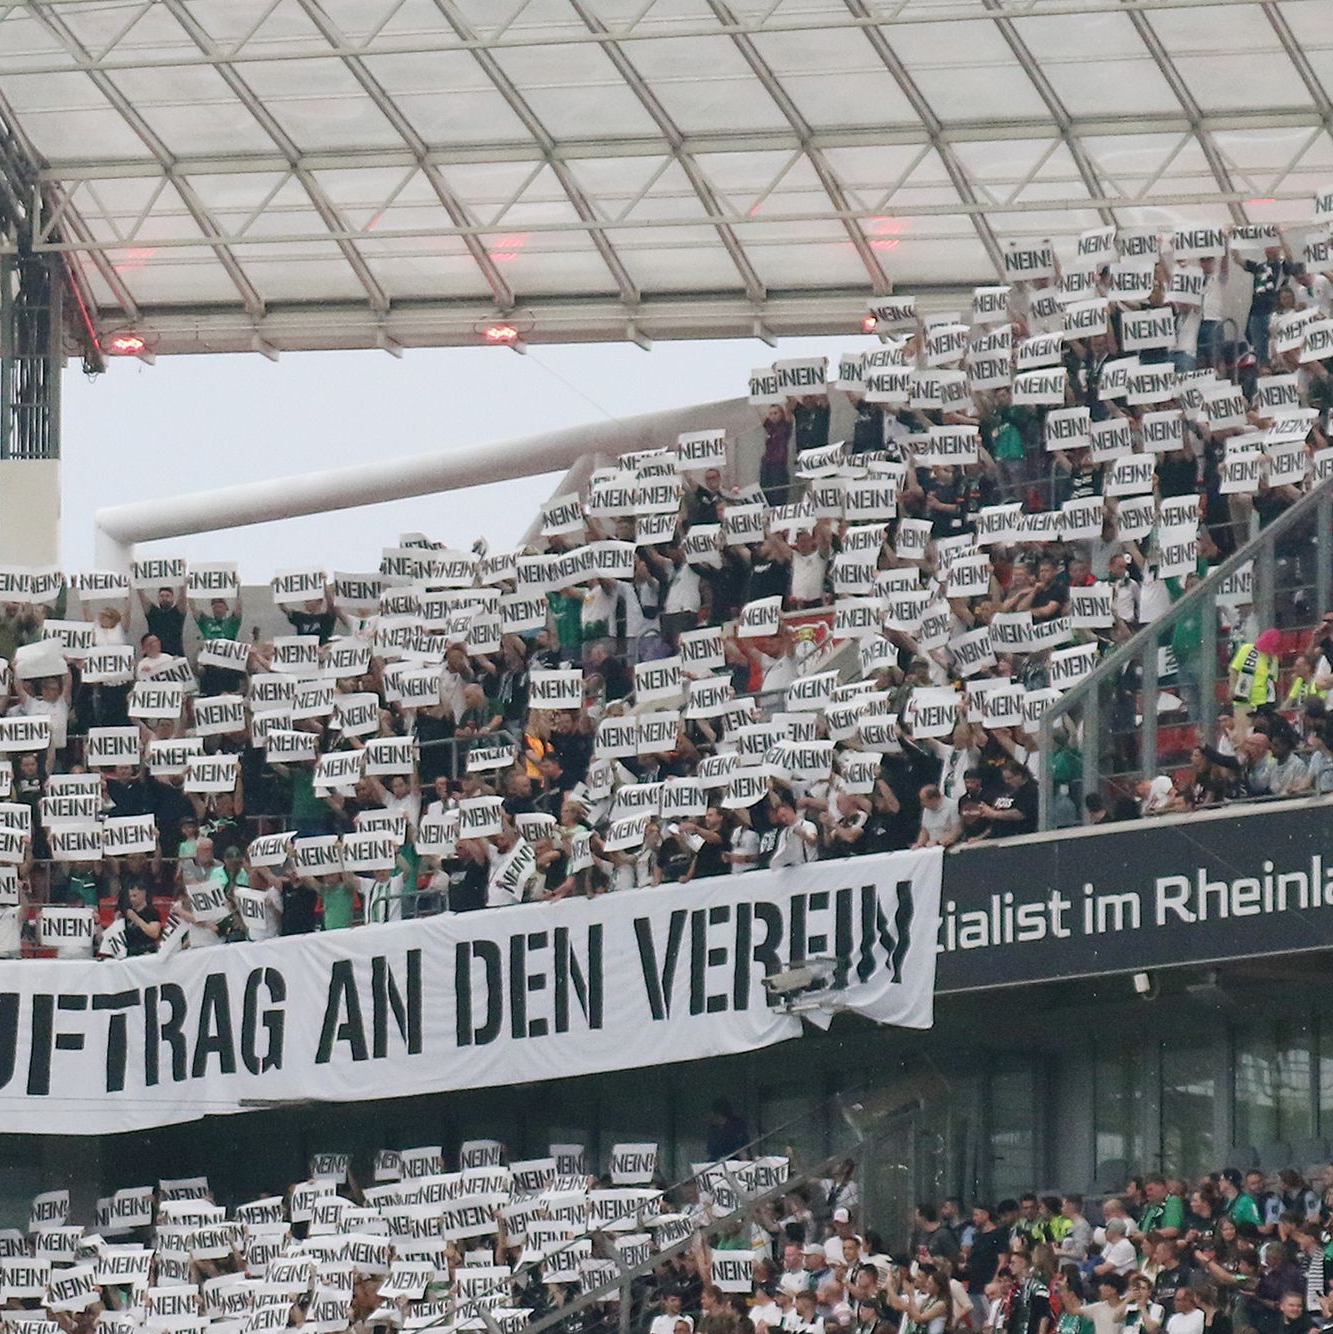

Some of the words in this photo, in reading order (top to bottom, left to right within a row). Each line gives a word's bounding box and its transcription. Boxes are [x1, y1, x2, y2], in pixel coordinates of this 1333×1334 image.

[1005, 250, 1051, 271] NEIN!
[1124, 318, 1172, 340] NEIN!
[1014, 376, 1062, 394] NEIN!
[930, 435, 975, 454] NEIN!
[846, 489, 894, 509] NEIN!
[271, 572, 326, 593] NEIN!
[641, 667, 680, 690] NEIN!
[533, 680, 579, 698] NEIN!
[0, 723, 47, 743] NEIN!
[89, 737, 137, 755] NEIN!
[188, 764, 233, 782] NEIN!
[343, 840, 392, 861] NEIN!
[1083, 882, 1140, 936] im
[316, 947, 422, 1064] AN
[455, 923, 605, 1046] DEN
[633, 880, 914, 1020] VEREIN
[612, 1154, 653, 1173] NEIN!
[712, 1261, 752, 1280] NEIN!
